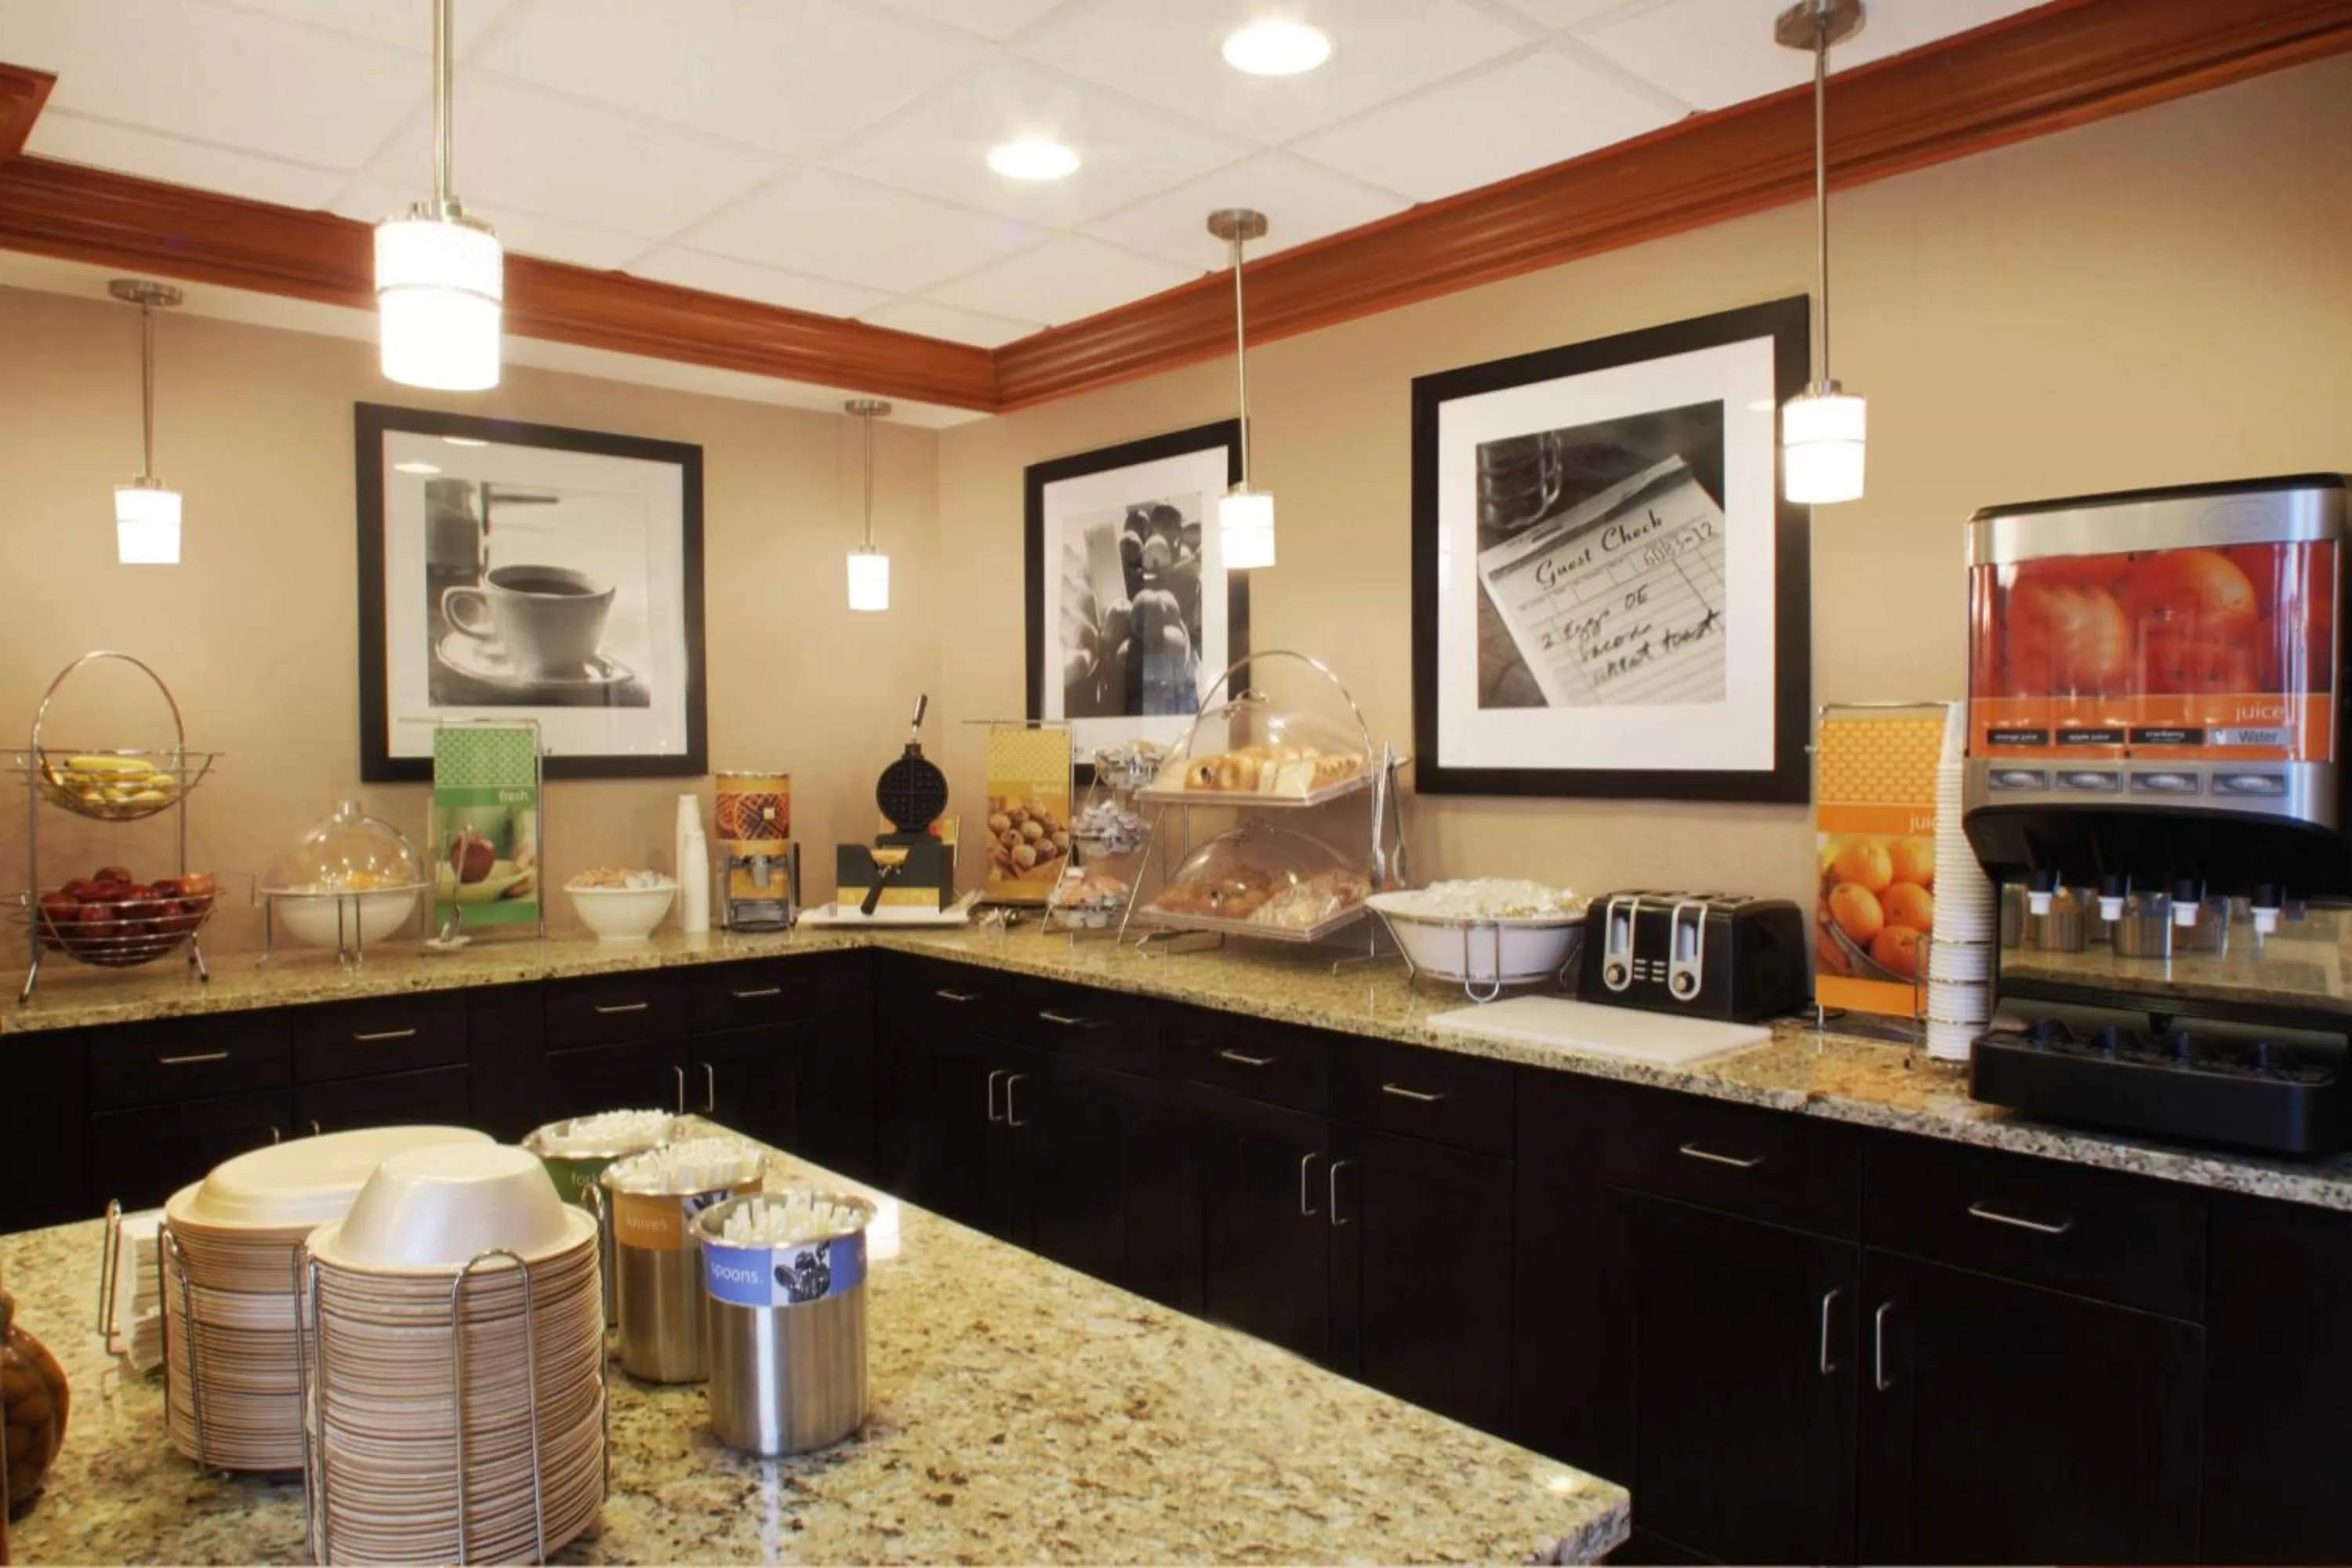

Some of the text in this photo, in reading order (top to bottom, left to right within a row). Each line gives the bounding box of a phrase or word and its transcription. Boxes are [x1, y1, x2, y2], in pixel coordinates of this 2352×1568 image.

[1536, 548, 1592, 590] Guest
[1601, 509, 1663, 552] Check
[2238, 730, 2279, 743] Water
[1908, 811, 1939, 833] juic
